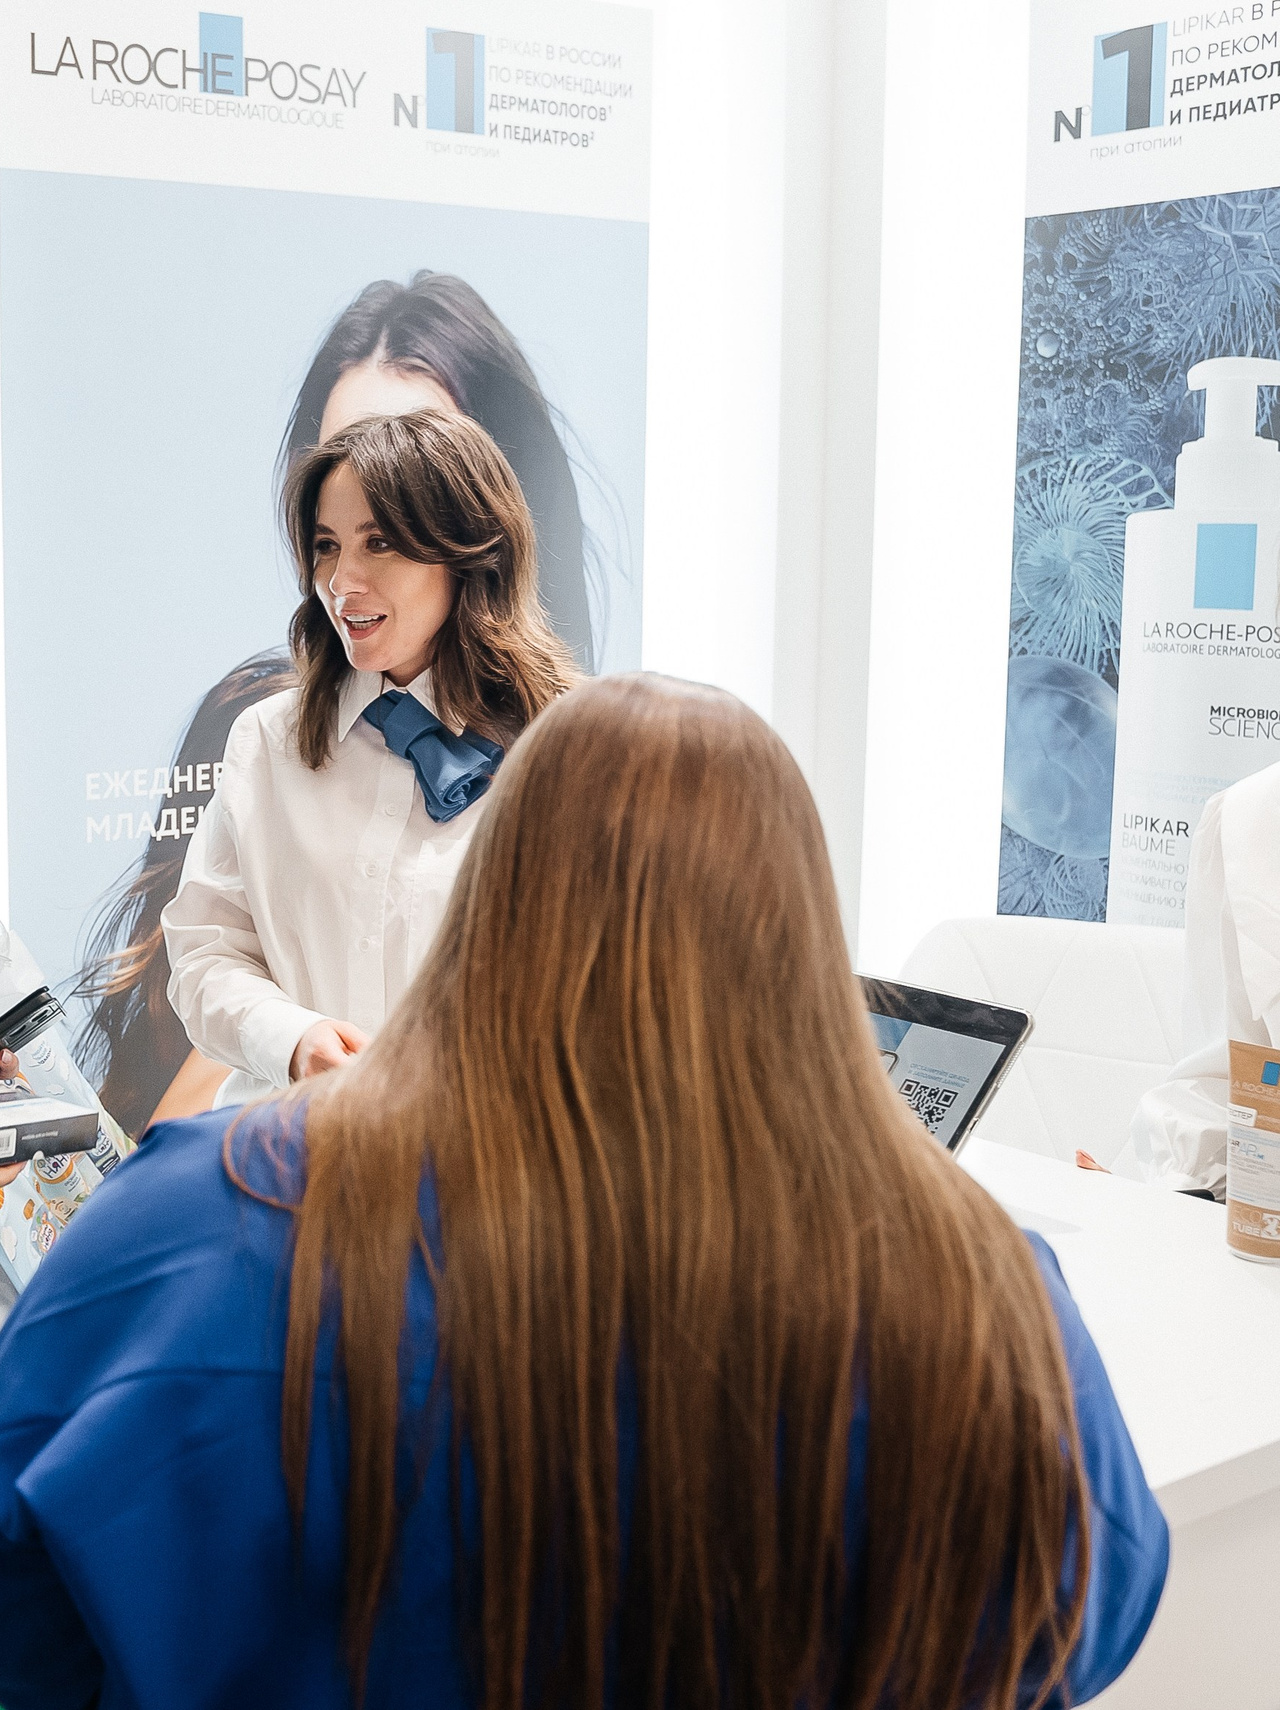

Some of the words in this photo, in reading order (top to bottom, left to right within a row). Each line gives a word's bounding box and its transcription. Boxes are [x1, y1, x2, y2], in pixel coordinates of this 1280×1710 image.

[1172, 7, 1244, 37] LIPIKAR
[558, 46, 622, 69] РОССИИ
[1172, 46, 1201, 67] ПО
[1208, 31, 1277, 60] РЕКОМ
[30, 32, 84, 80] LA
[92, 39, 234, 95] ROCHE
[244, 57, 366, 108] POSAY
[488, 65, 511, 84] ПО
[515, 68, 633, 99] РЕКОМЕНДАЦИИ
[1170, 60, 1280, 98] ДЕРМАТОЛ
[91, 87, 203, 115] LABORATOIRE
[205, 100, 345, 130] DERMATOLOGIQUE
[1169, 109, 1182, 126] И
[1189, 93, 1280, 123] ПЕДИАТР
[488, 122, 499, 139] И
[1090, 146, 1119, 161] при
[1124, 136, 1183, 153] атопии
[1143, 621, 1162, 638] LA
[1142, 642, 1204, 656] LABORATOIRE
[1210, 705, 1280, 721] MICROBIO
[1123, 813, 1190, 838] LIPIKAR
[1122, 832, 1176, 857] BAUME
[1232, 1221, 1261, 1237] TUBE
